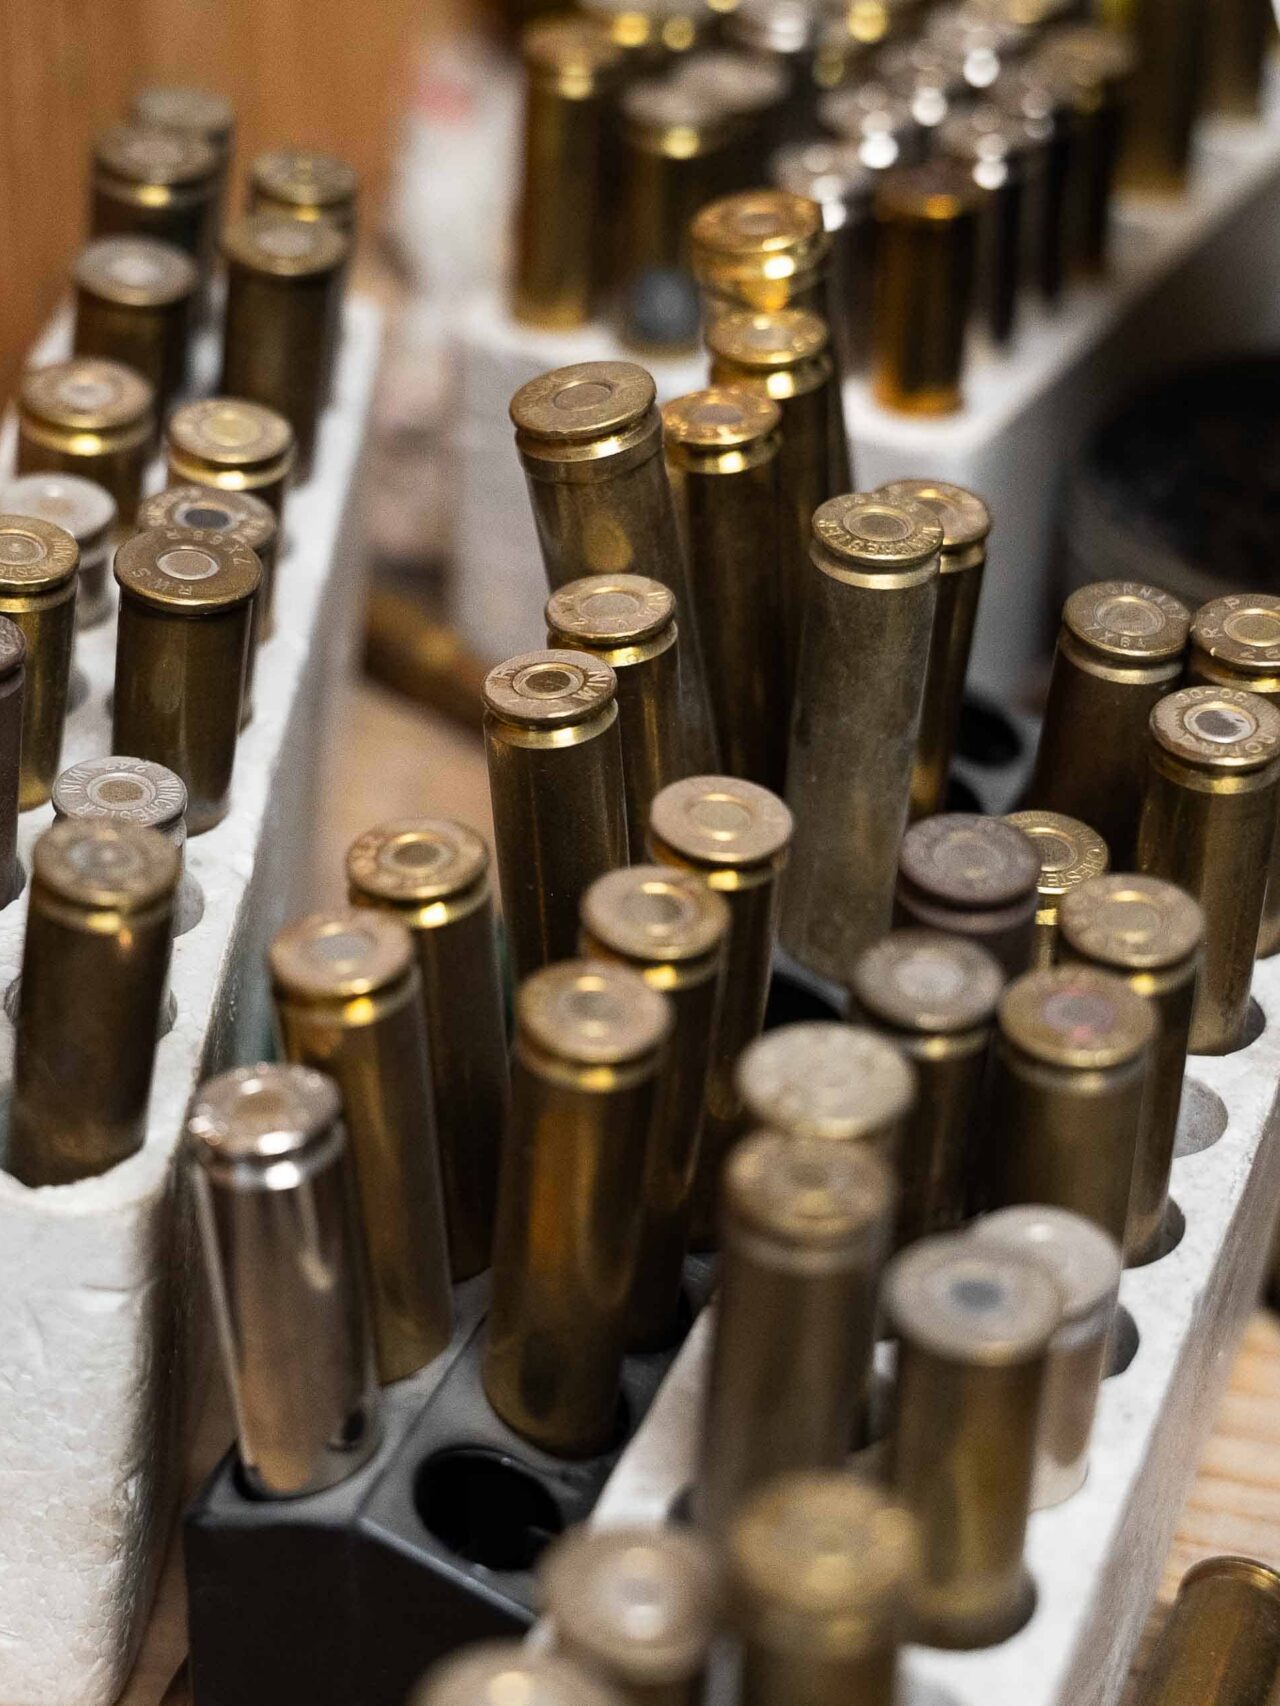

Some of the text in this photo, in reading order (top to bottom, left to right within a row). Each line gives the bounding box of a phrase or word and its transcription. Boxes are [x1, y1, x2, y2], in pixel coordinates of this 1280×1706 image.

[571, 670, 610, 702] WIN
[1175, 687, 1248, 705] 30-06
[60, 768, 93, 794] WIN
[76, 777, 183, 824] WINCHESTER
